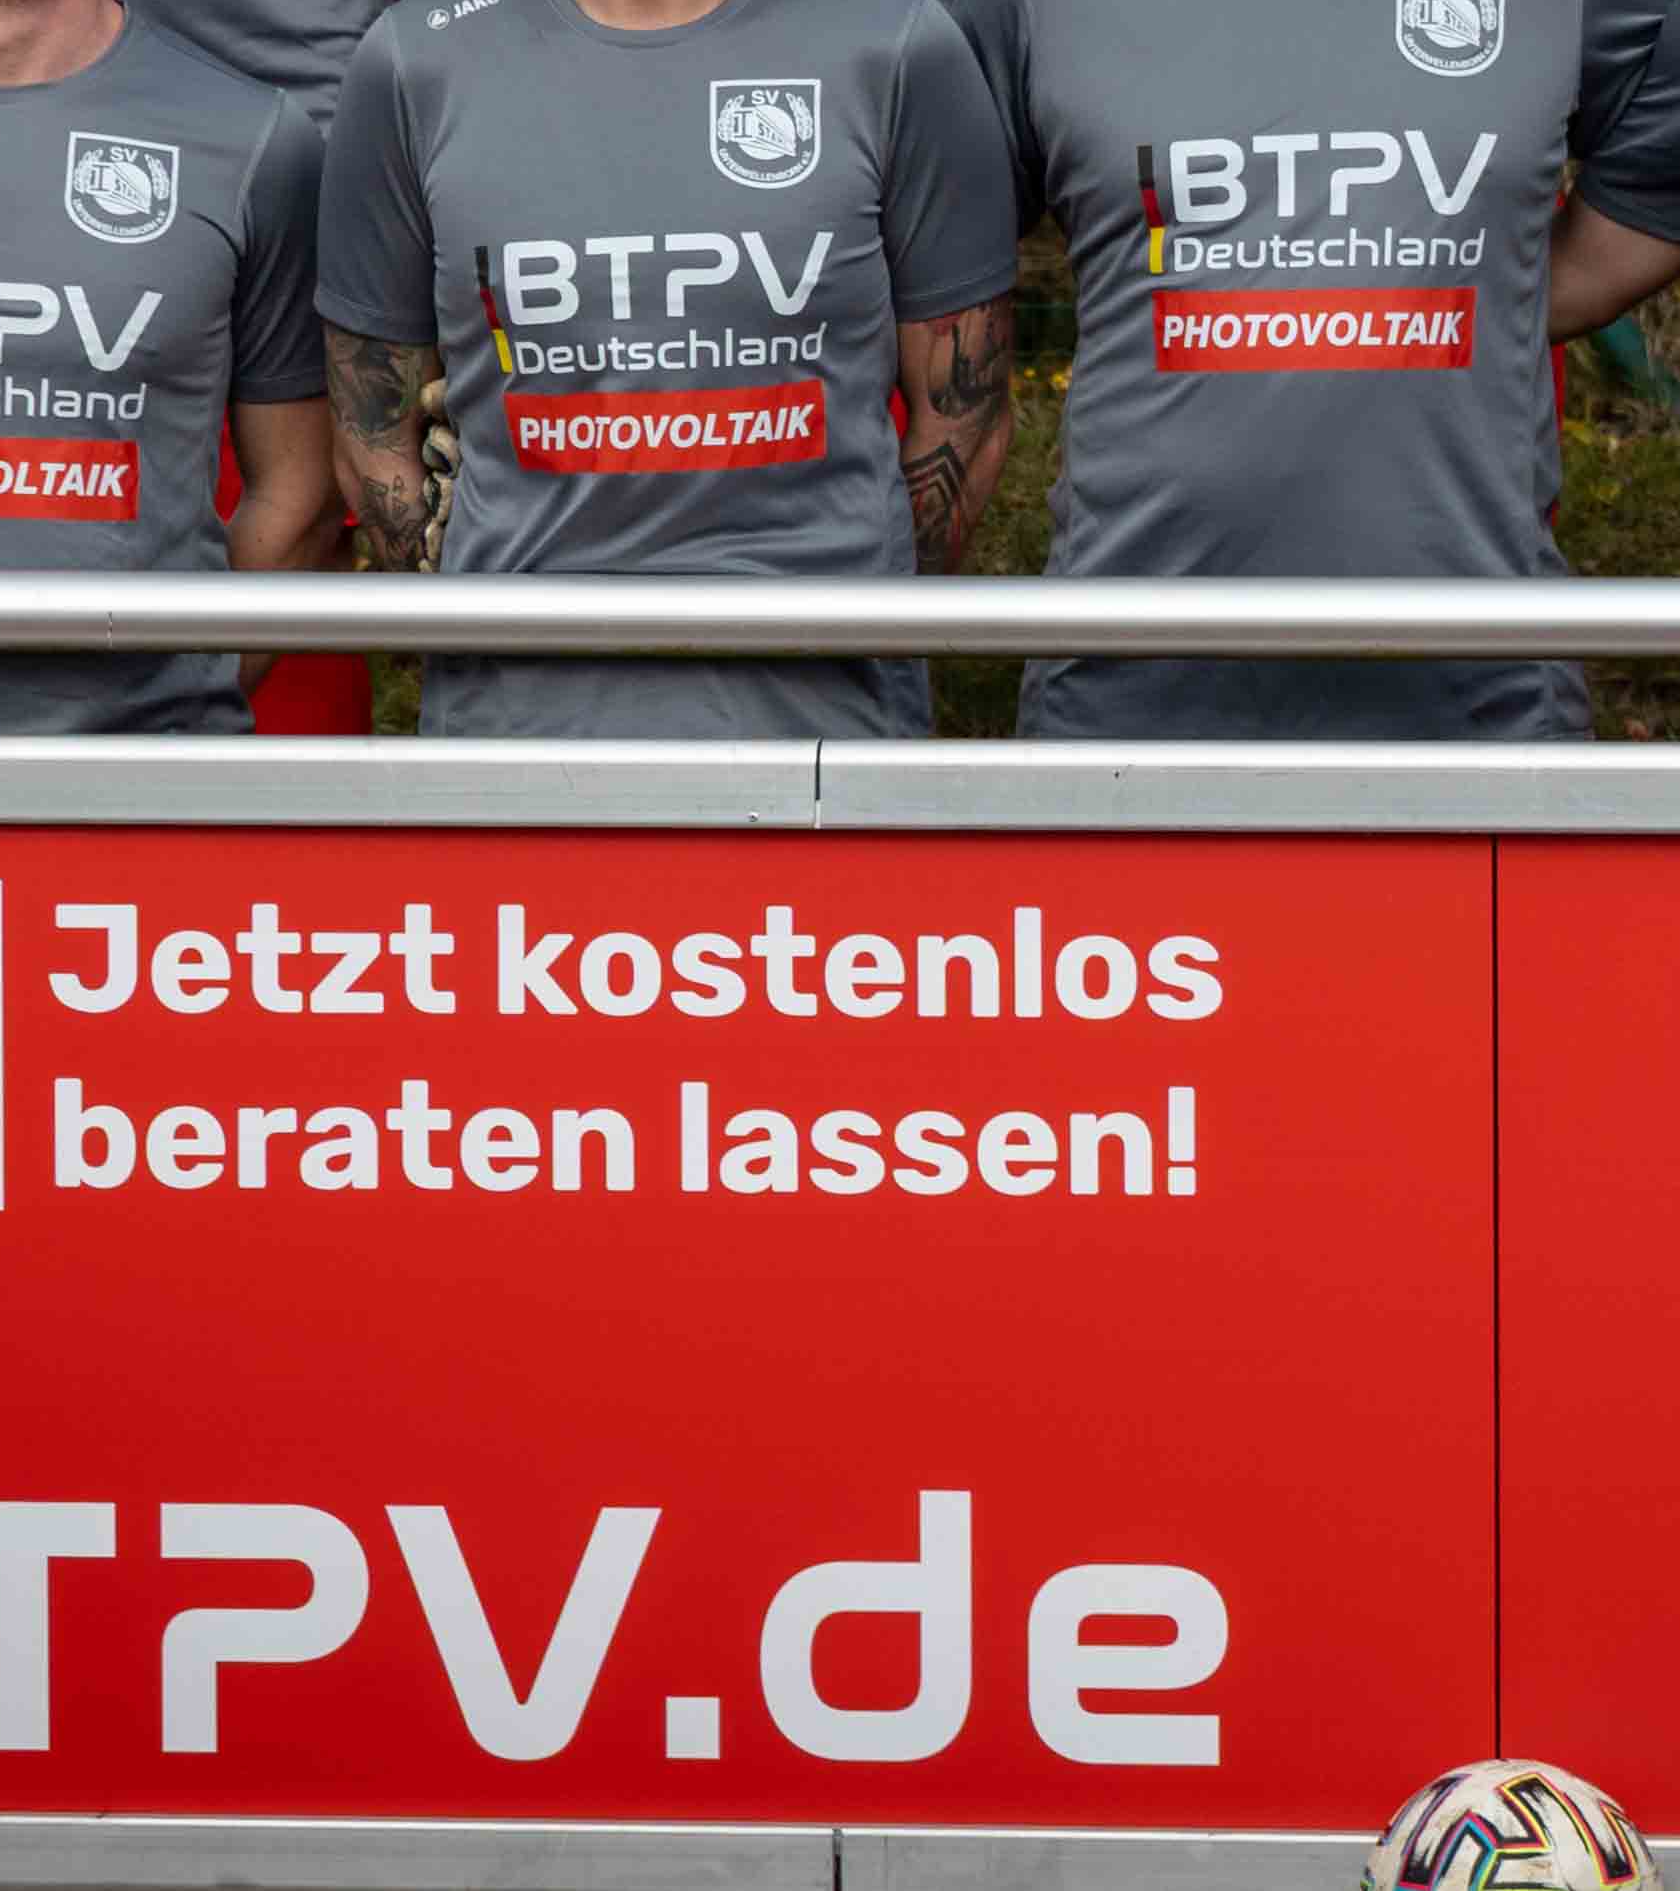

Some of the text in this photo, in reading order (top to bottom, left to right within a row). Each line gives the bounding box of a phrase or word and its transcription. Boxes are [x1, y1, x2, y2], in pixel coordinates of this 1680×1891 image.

[751, 90, 779, 105] SV
[110, 146, 138, 162] SV
[1169, 129, 1498, 223] BTPV
[1174, 226, 1485, 272] Deutschland
[503, 231, 834, 325] BTPV
[511, 318, 826, 375] Deutschland
[1163, 311, 1464, 349] PHOTOVOLTAIK
[519, 403, 815, 451] PHOTOVOLTAIK
[49, 904, 1222, 1020] Jetzt kostenlos
[55, 1078, 1196, 1195] beraten lassen!
